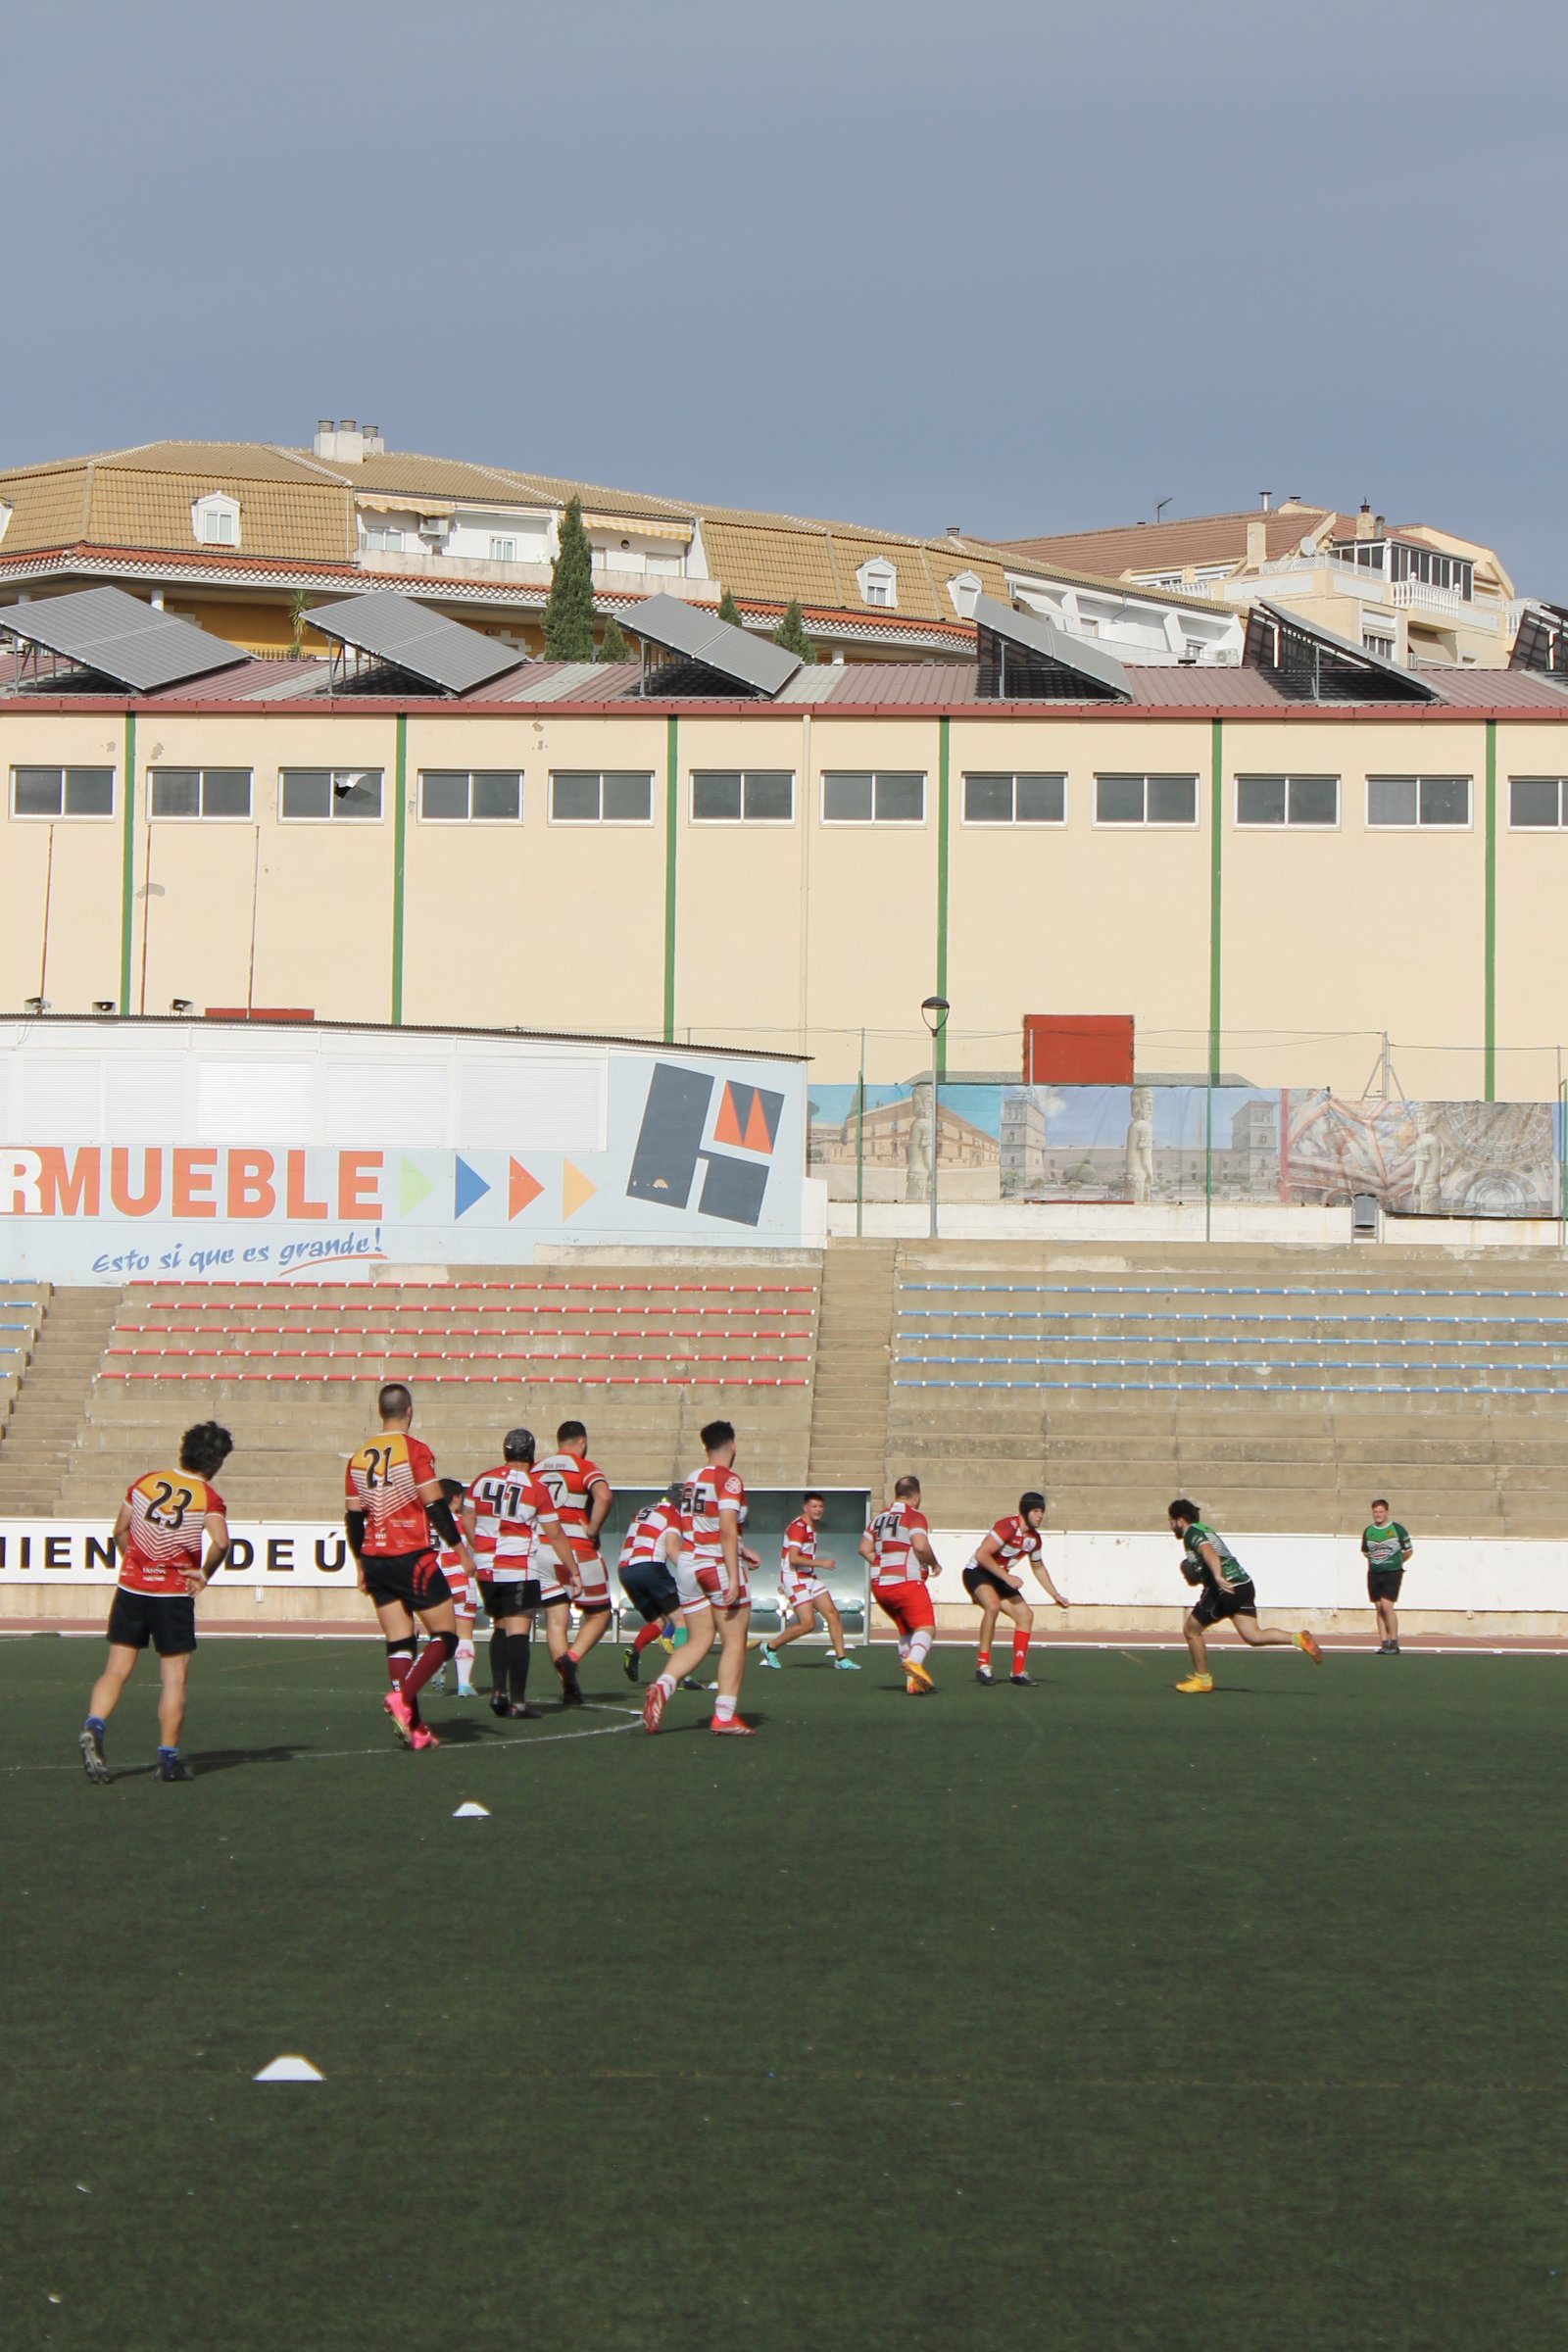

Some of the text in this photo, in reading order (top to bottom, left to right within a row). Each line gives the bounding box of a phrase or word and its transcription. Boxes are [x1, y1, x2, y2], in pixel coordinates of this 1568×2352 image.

[0, 1148, 383, 1220] RMUEBLE
[91, 1227, 382, 1274] Esto si que es grande!
[364, 1446, 394, 1490] 21
[144, 1481, 193, 1531] 23
[481, 1481, 521, 1519] 41
[0, 1537, 117, 1569] IEN
[224, 1539, 294, 1571] DE
